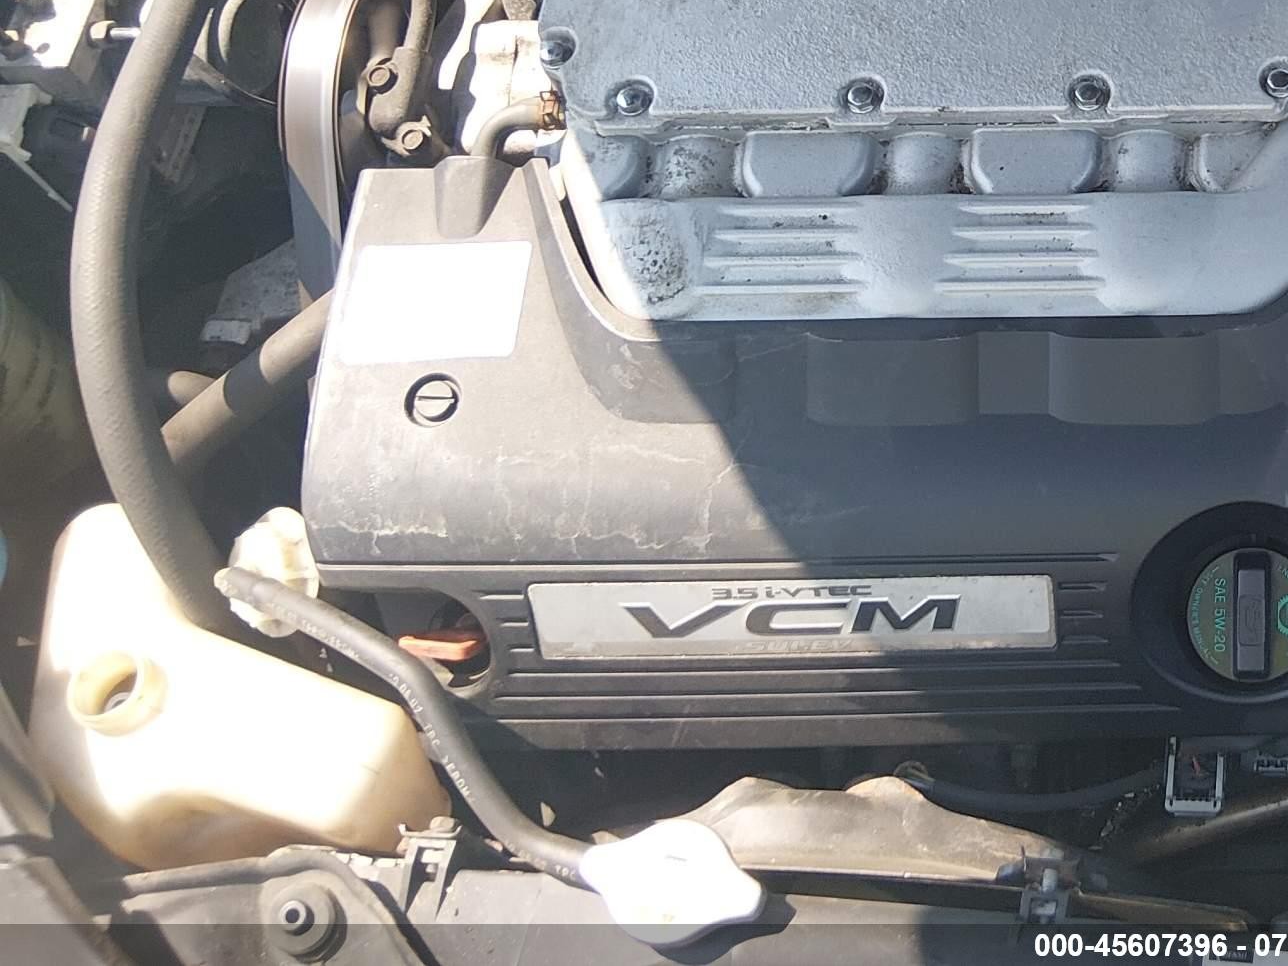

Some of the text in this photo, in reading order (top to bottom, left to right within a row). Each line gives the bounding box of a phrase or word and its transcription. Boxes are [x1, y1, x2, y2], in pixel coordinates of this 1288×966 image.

[712, 585, 872, 600] 3.5 i-VTEC
[619, 595, 961, 638] VCM
[1214, 578, 1226, 652] SAE 5W-20
